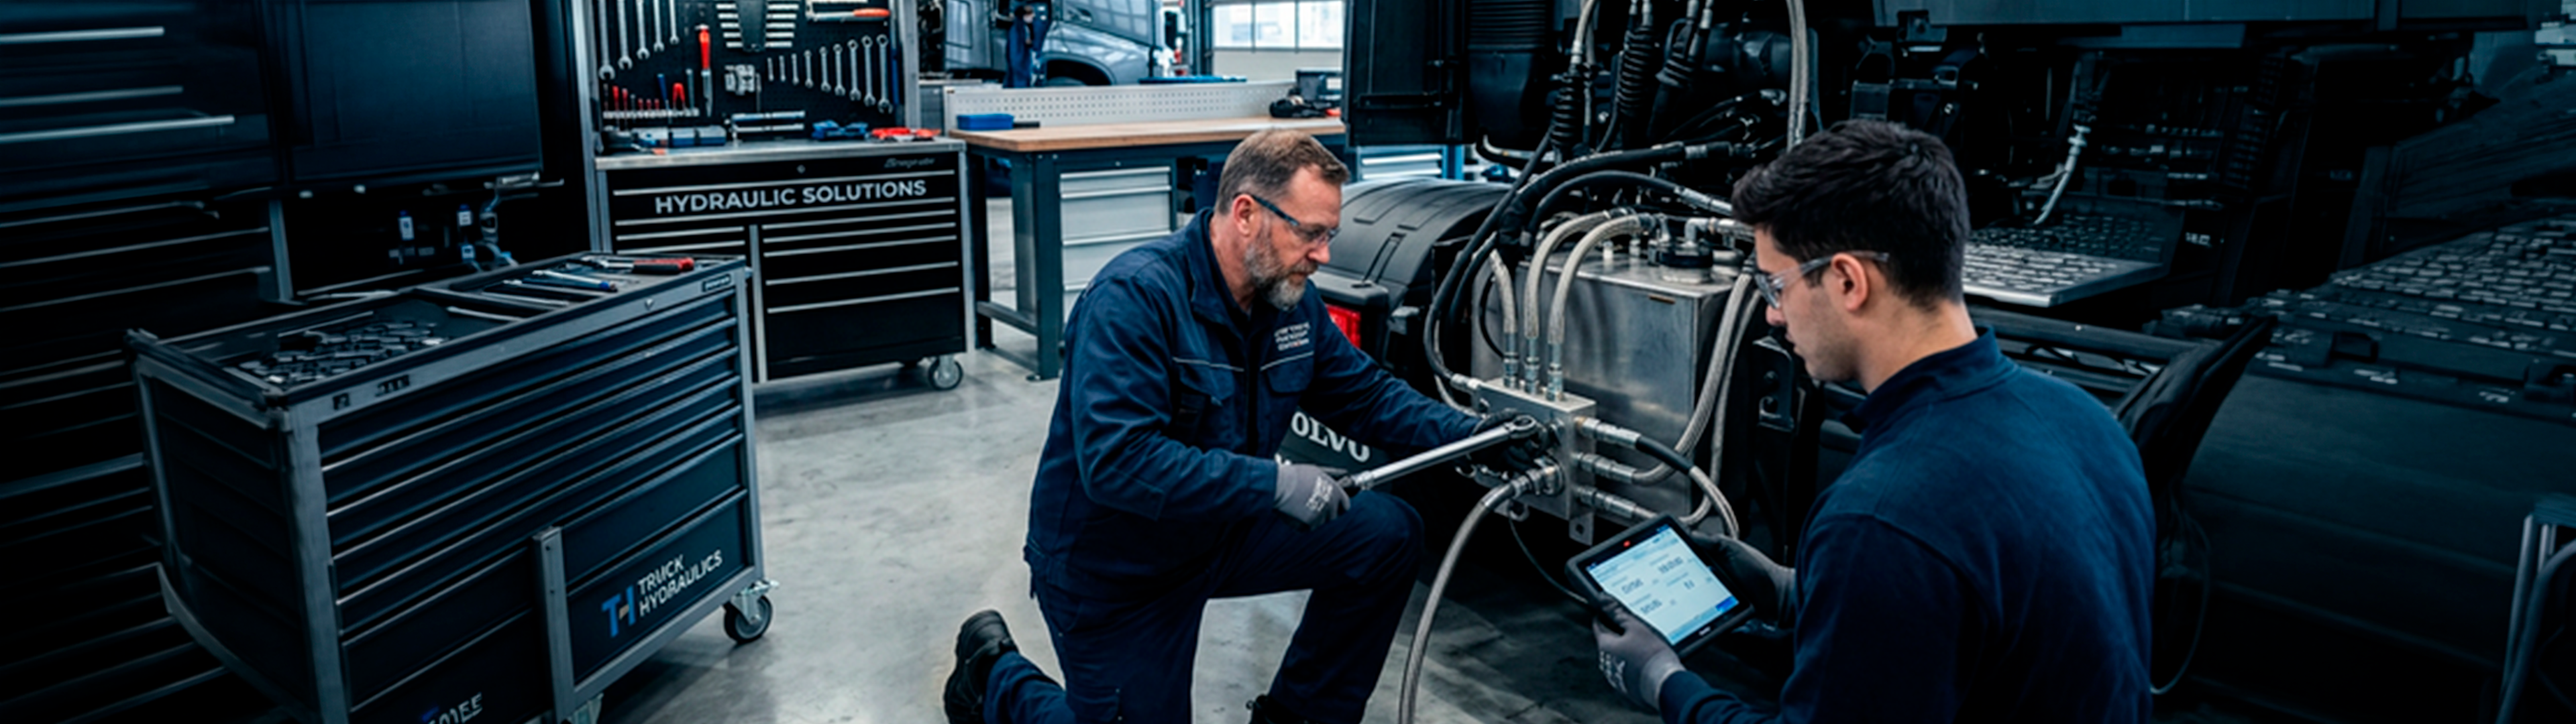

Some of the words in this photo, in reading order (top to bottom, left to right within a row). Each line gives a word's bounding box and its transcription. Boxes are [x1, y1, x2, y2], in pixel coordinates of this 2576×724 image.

[655, 188, 796, 214] HYDRAULIC
[802, 180, 926, 204] SOLUTIONS
[1291, 411, 1371, 463] OLVO
[638, 554, 684, 595] TRUCK
[639, 550, 723, 617] HYDRAULICS
